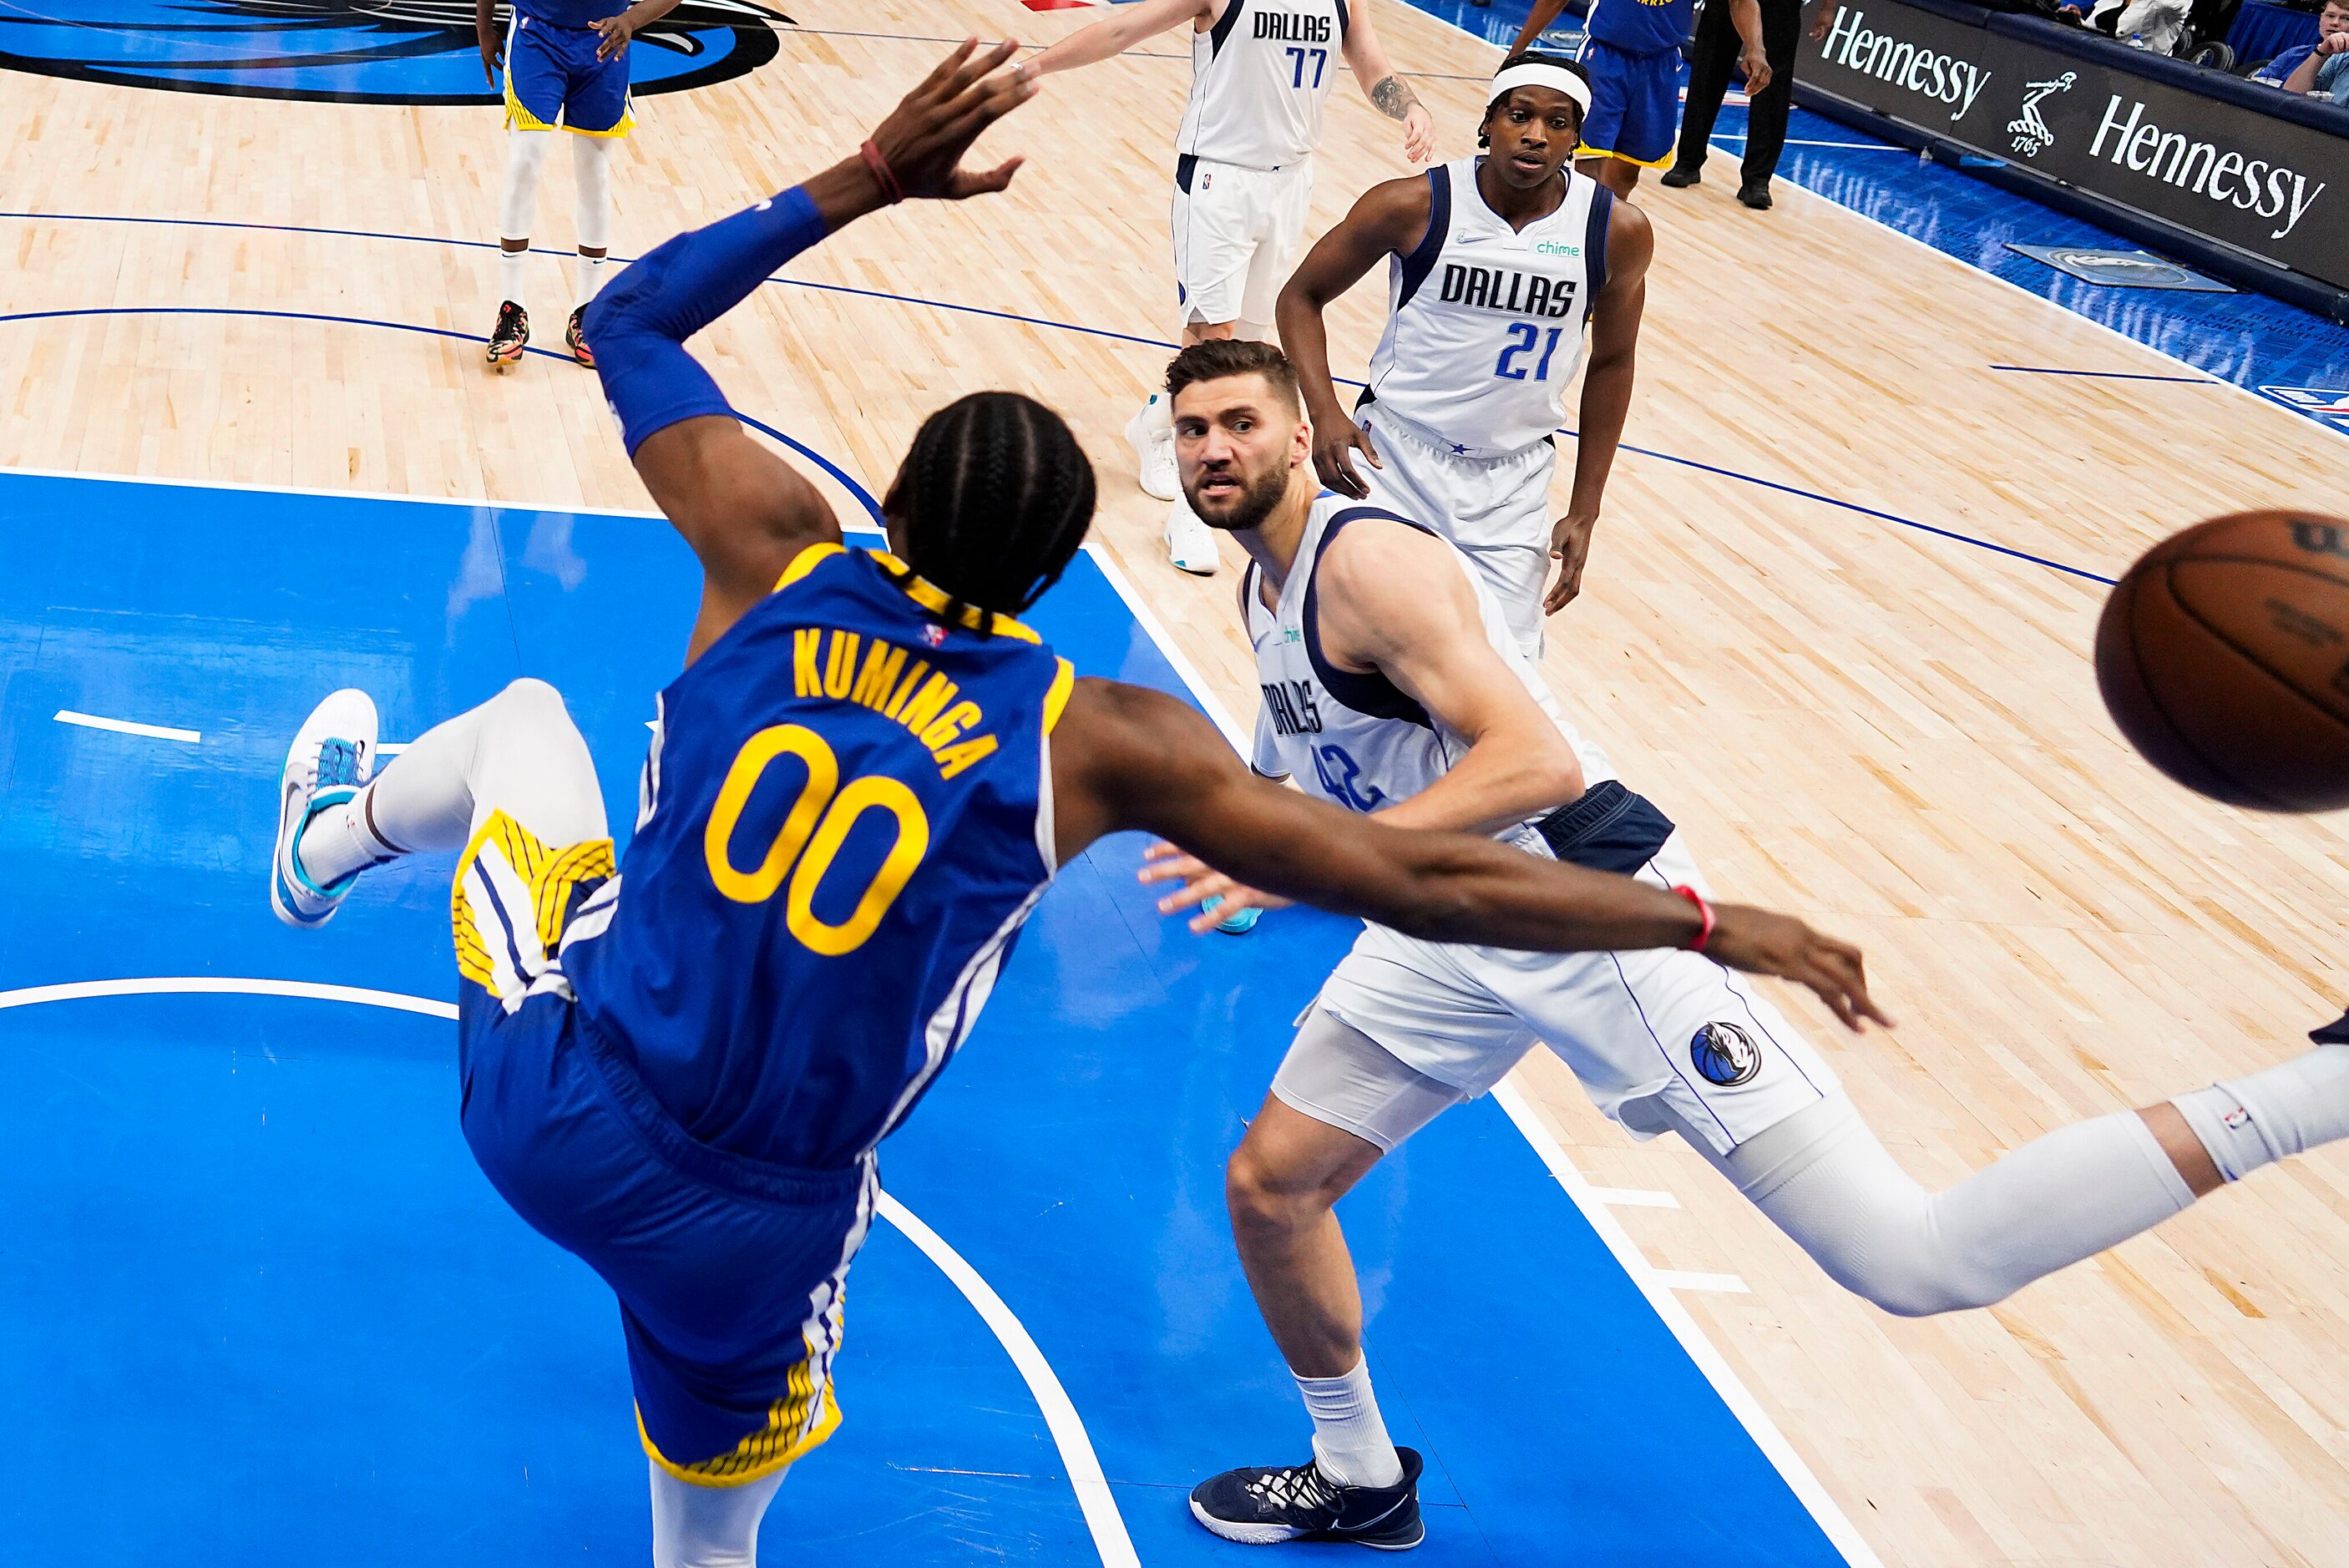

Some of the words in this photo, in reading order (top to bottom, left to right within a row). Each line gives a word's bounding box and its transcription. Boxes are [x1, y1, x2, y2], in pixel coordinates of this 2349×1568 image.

[1253, 11, 1330, 43] DALLAS
[1286, 47, 1327, 89] 77
[1821, 5, 1992, 120] Hennessy
[2011, 135, 2042, 158] 1765
[2088, 94, 2326, 240] Hennessy
[1536, 240, 1580, 256] chime
[1440, 263, 1578, 319] DALLAS
[1495, 321, 1564, 382] 21
[793, 628, 999, 781] KUMINGA
[1311, 742, 1388, 812] 42
[704, 723, 929, 957] 00
